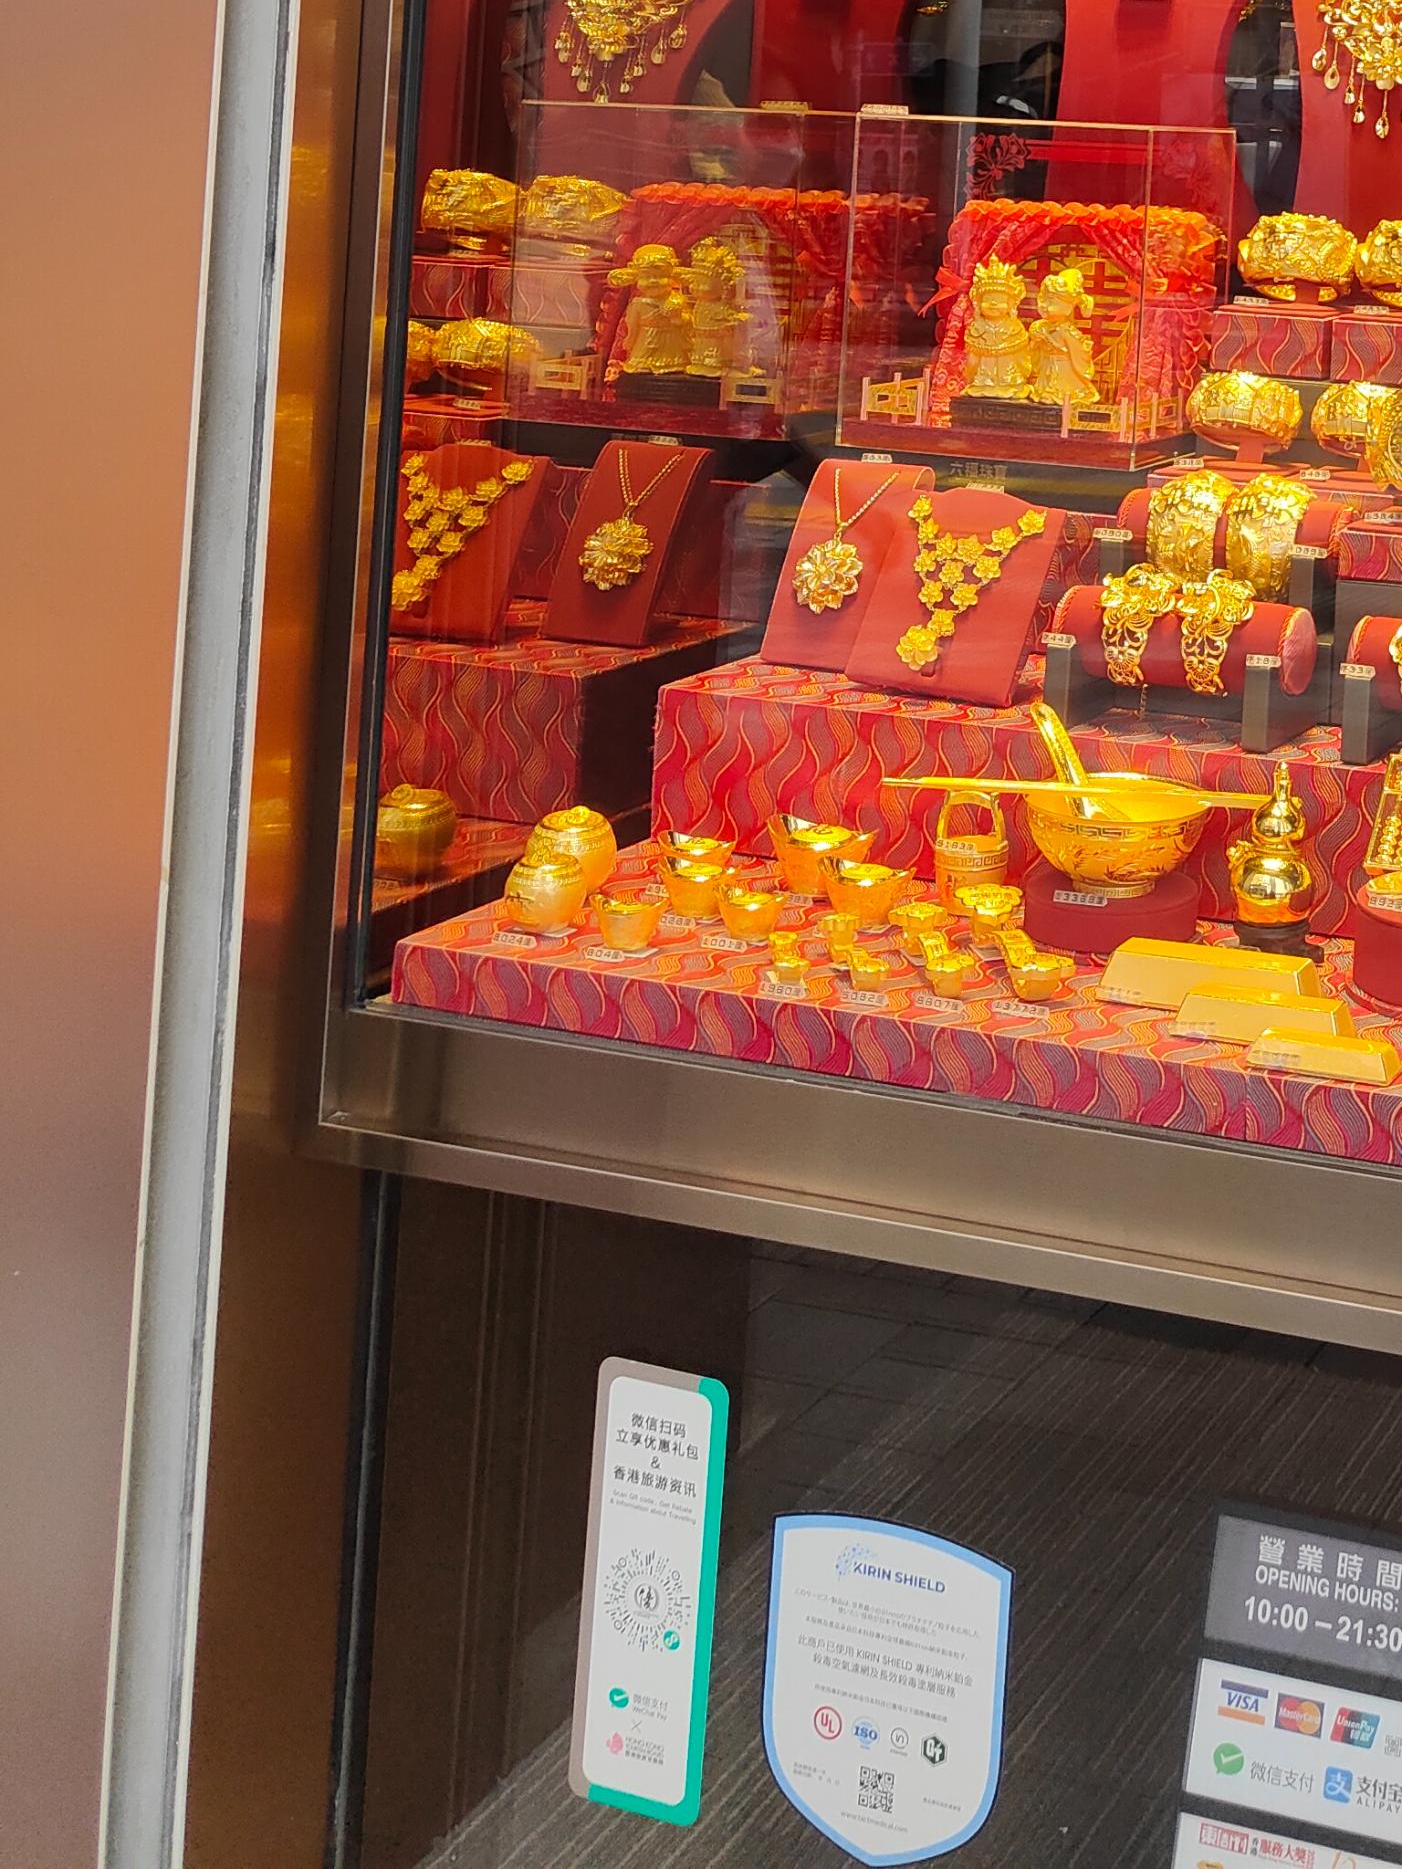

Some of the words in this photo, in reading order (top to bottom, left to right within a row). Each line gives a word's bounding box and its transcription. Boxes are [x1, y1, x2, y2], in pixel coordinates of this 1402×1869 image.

[631, 1412, 686, 1439] 微信扫码
[615, 1428, 698, 1460] 立享优惠礼包
[650, 1456, 662, 1470] &
[613, 1464, 697, 1498] 香港旅游资讯
[853, 1561, 893, 1582] KIRIN
[894, 1571, 946, 1594] SHIELD
[1255, 1564, 1331, 1599] OPENING
[1335, 1582, 1401, 1613] HOURS:
[1244, 1595, 1310, 1632] 10:00
[856, 1648, 880, 1664] KIRIN
[882, 1655, 914, 1672] SHIELD
[1226, 1691, 1260, 1713] VISA
[854, 1725, 878, 1741] ISO
[1336, 1714, 1376, 1735] UnionPay
[1250, 1760, 1314, 1794] 微信支付
[1356, 1796, 1401, 1817] ALIPAY
